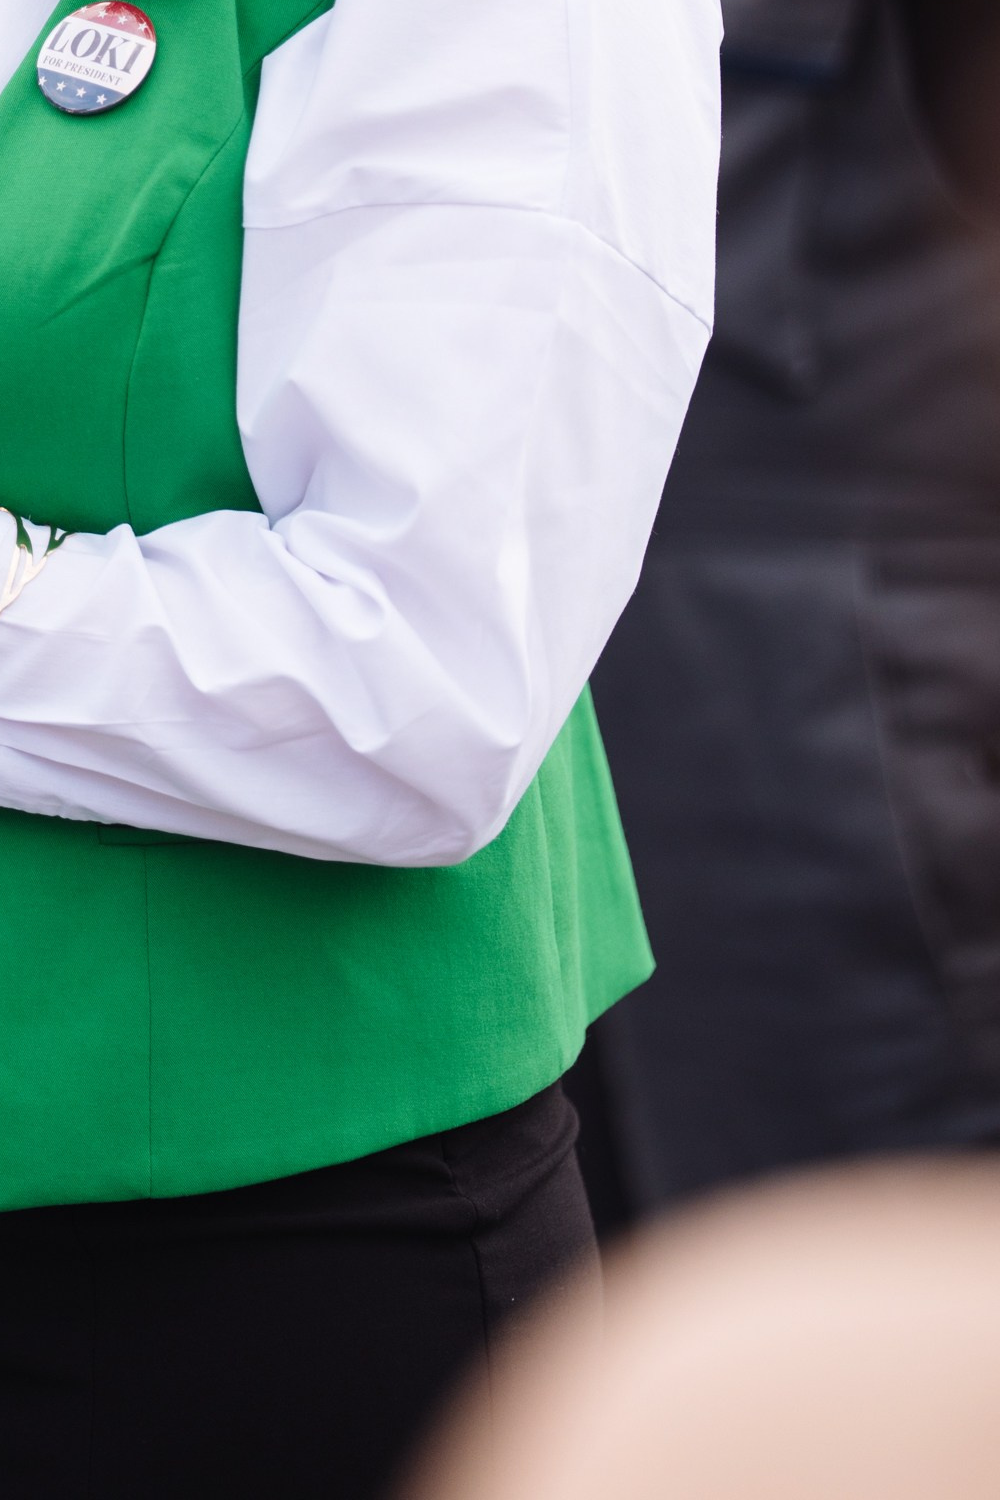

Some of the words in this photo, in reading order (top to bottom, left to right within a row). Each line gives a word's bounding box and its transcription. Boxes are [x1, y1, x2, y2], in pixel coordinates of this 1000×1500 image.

[46, 20, 147, 75] LOKI
[42, 55, 64, 69] FOR
[64, 60, 123, 87] PRESIDENT
